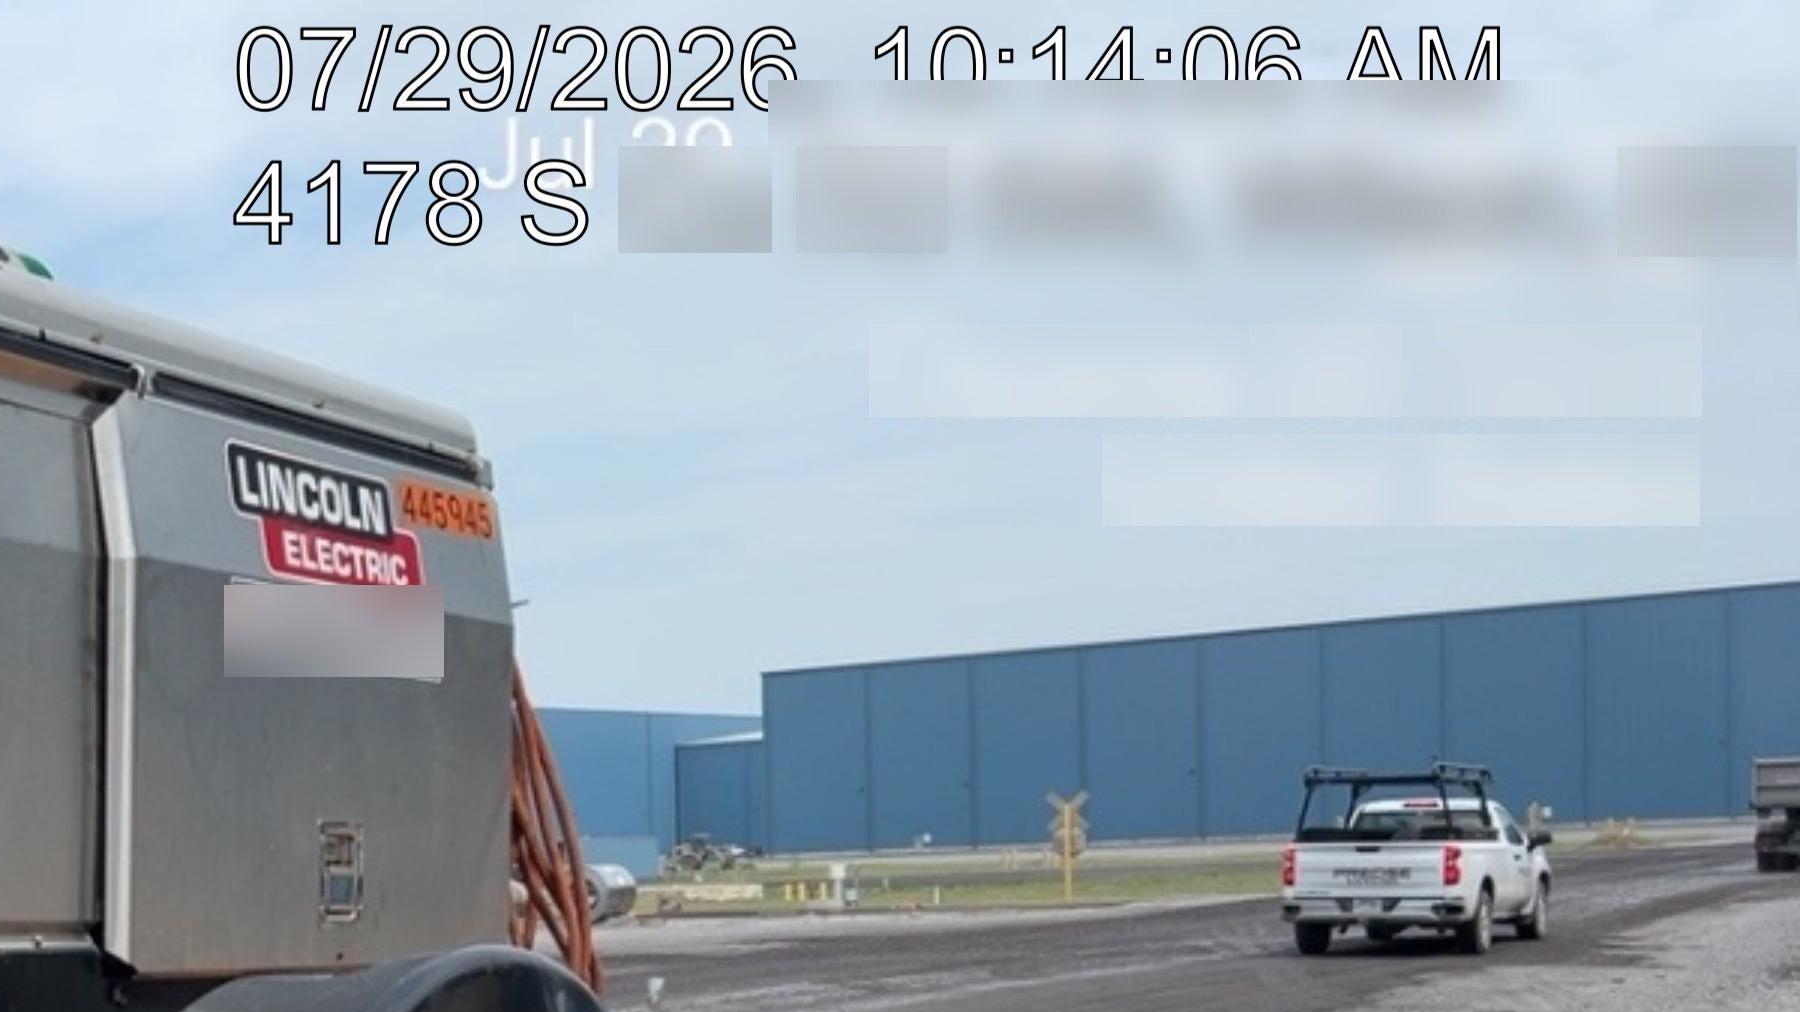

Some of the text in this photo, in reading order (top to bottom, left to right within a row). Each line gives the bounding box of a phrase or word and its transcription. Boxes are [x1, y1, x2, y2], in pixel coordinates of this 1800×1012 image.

[235, 455, 387, 536] LINCOLN
[402, 486, 492, 538] 445945
[282, 530, 409, 585] ELECTRIC
